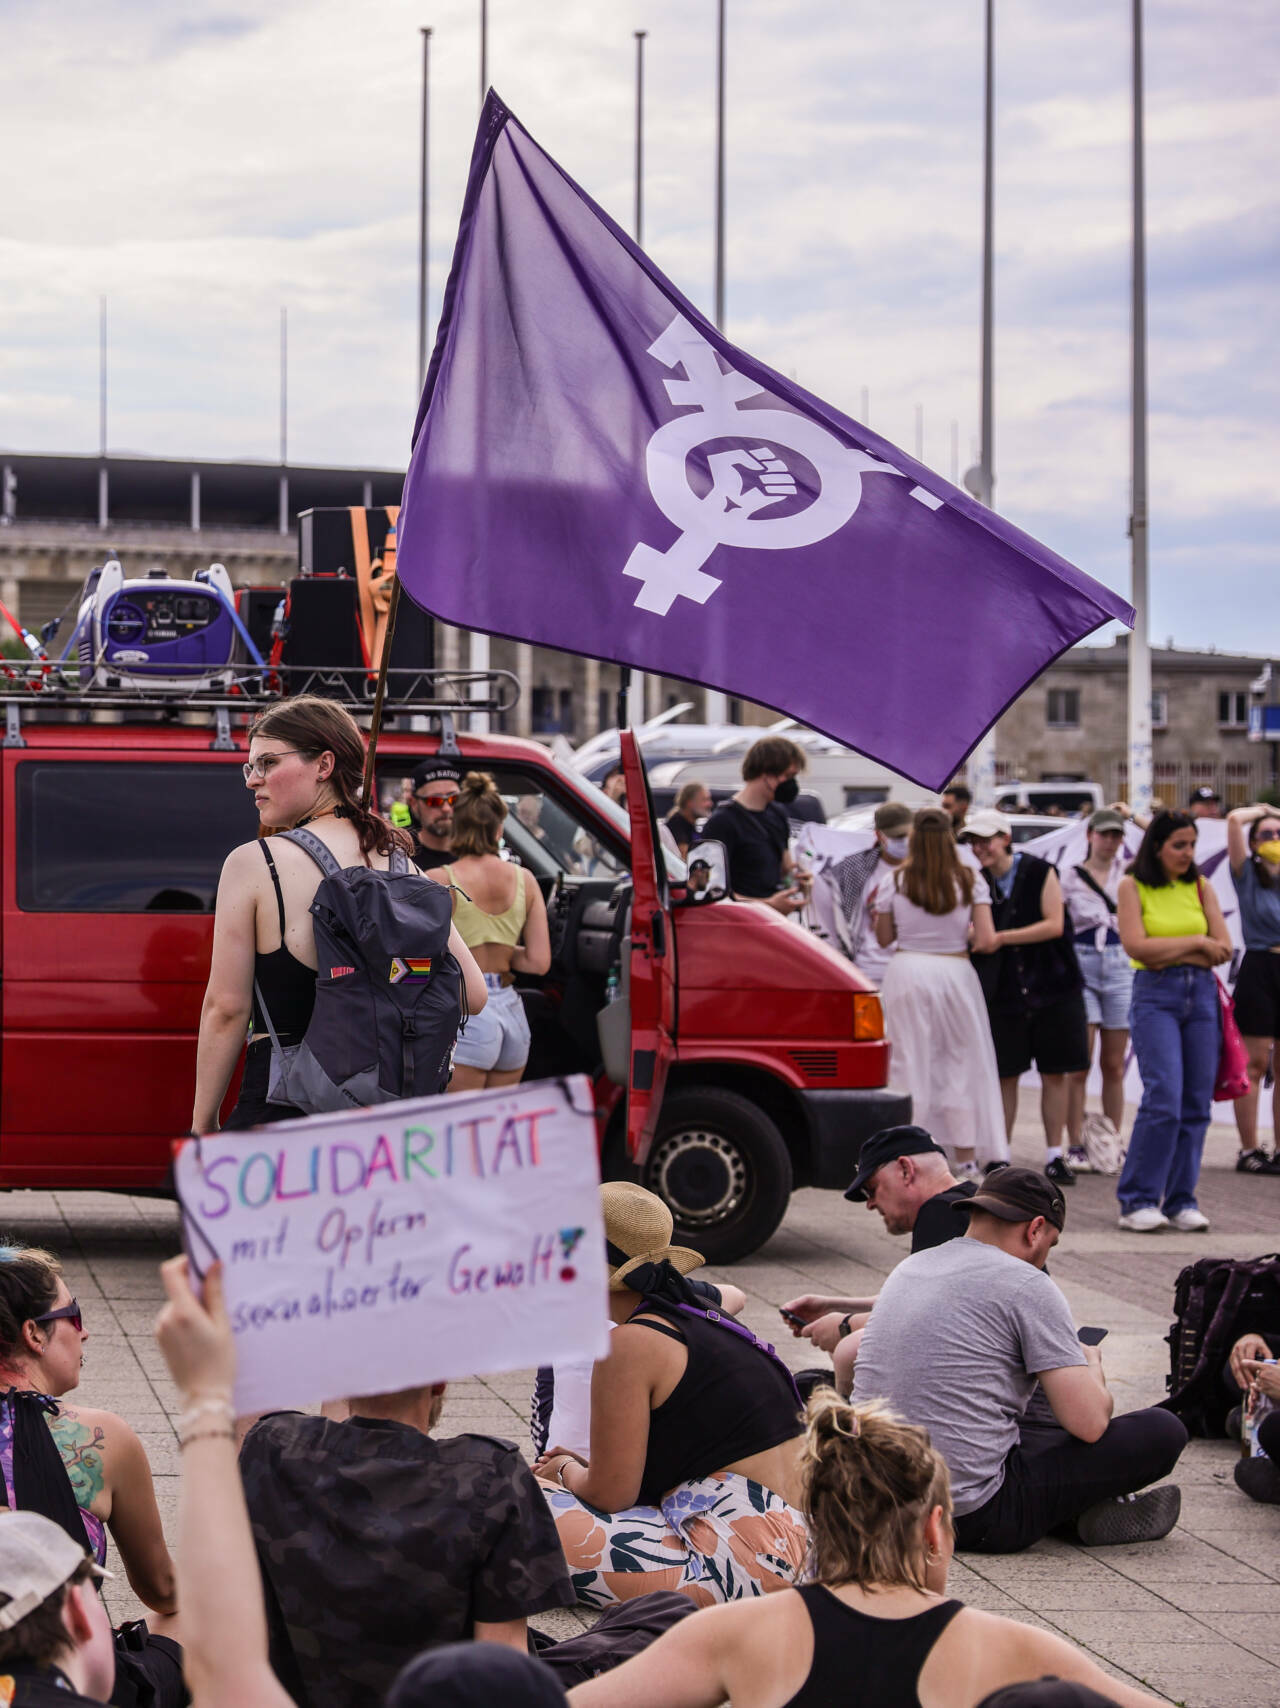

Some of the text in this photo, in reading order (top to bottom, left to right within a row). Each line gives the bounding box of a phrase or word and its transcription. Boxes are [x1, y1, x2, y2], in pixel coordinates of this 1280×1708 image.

[199, 1104, 558, 1219] SOLIDARITÄT
[232, 1197, 426, 1270] mit Opfern
